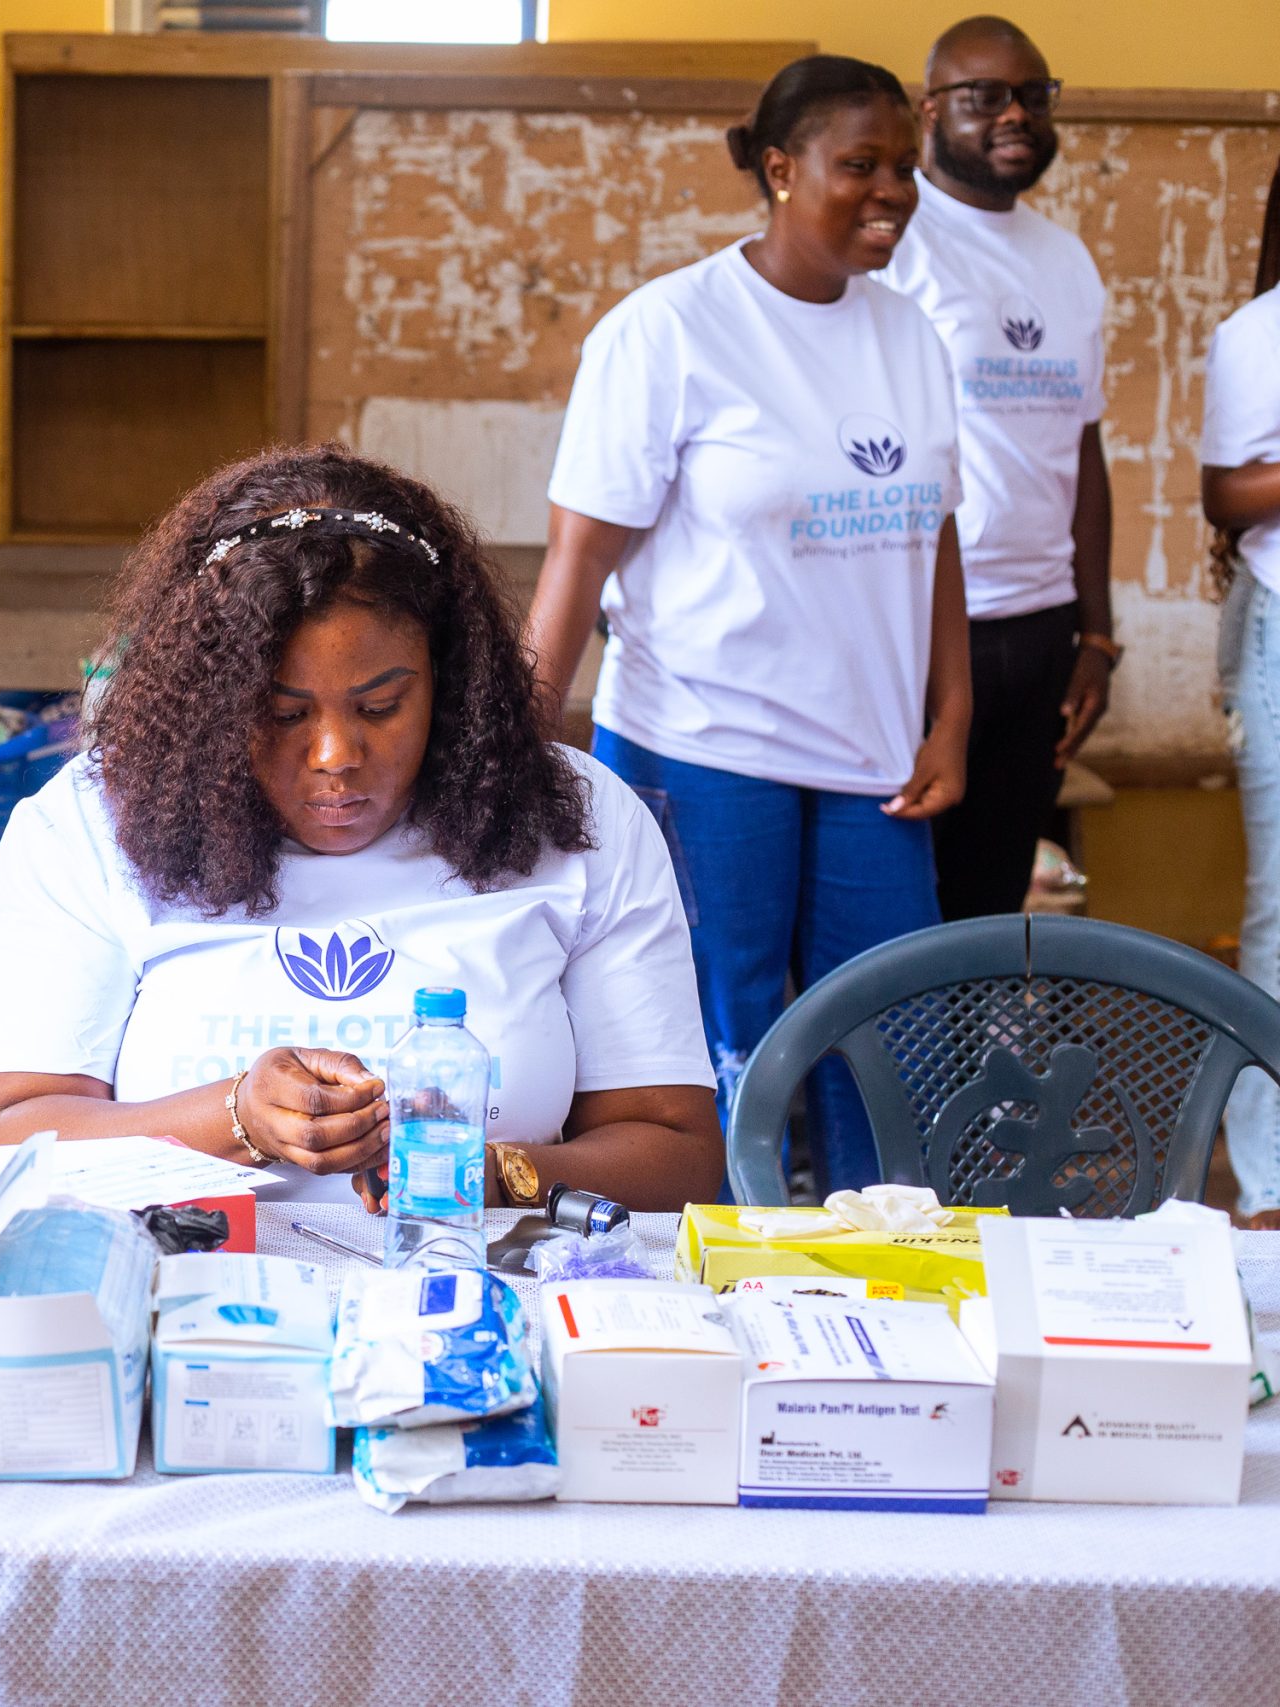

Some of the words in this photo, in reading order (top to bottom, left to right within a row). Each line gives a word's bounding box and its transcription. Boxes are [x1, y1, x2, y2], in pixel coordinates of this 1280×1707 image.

[975, 357, 1010, 375] THE
[1016, 358, 1078, 377] LOTUS
[962, 379, 1085, 399] FOUNDATION
[807, 489, 861, 513] THE
[868, 481, 943, 509] LOTUS
[790, 510, 945, 540] FOUNDATIO
[200, 1014, 294, 1047] THE
[742, 1281, 763, 1290] AA
[777, 1402, 818, 1415] Malaria
[857, 1403, 897, 1418] Antigen
[899, 1403, 921, 1417] Test
[1097, 1421, 1151, 1430] ADVANCED
[1155, 1422, 1197, 1432] QUALITY
[1110, 1431, 1155, 1441] MEDICAL
[1157, 1432, 1224, 1443] DIAGNOSTICS
